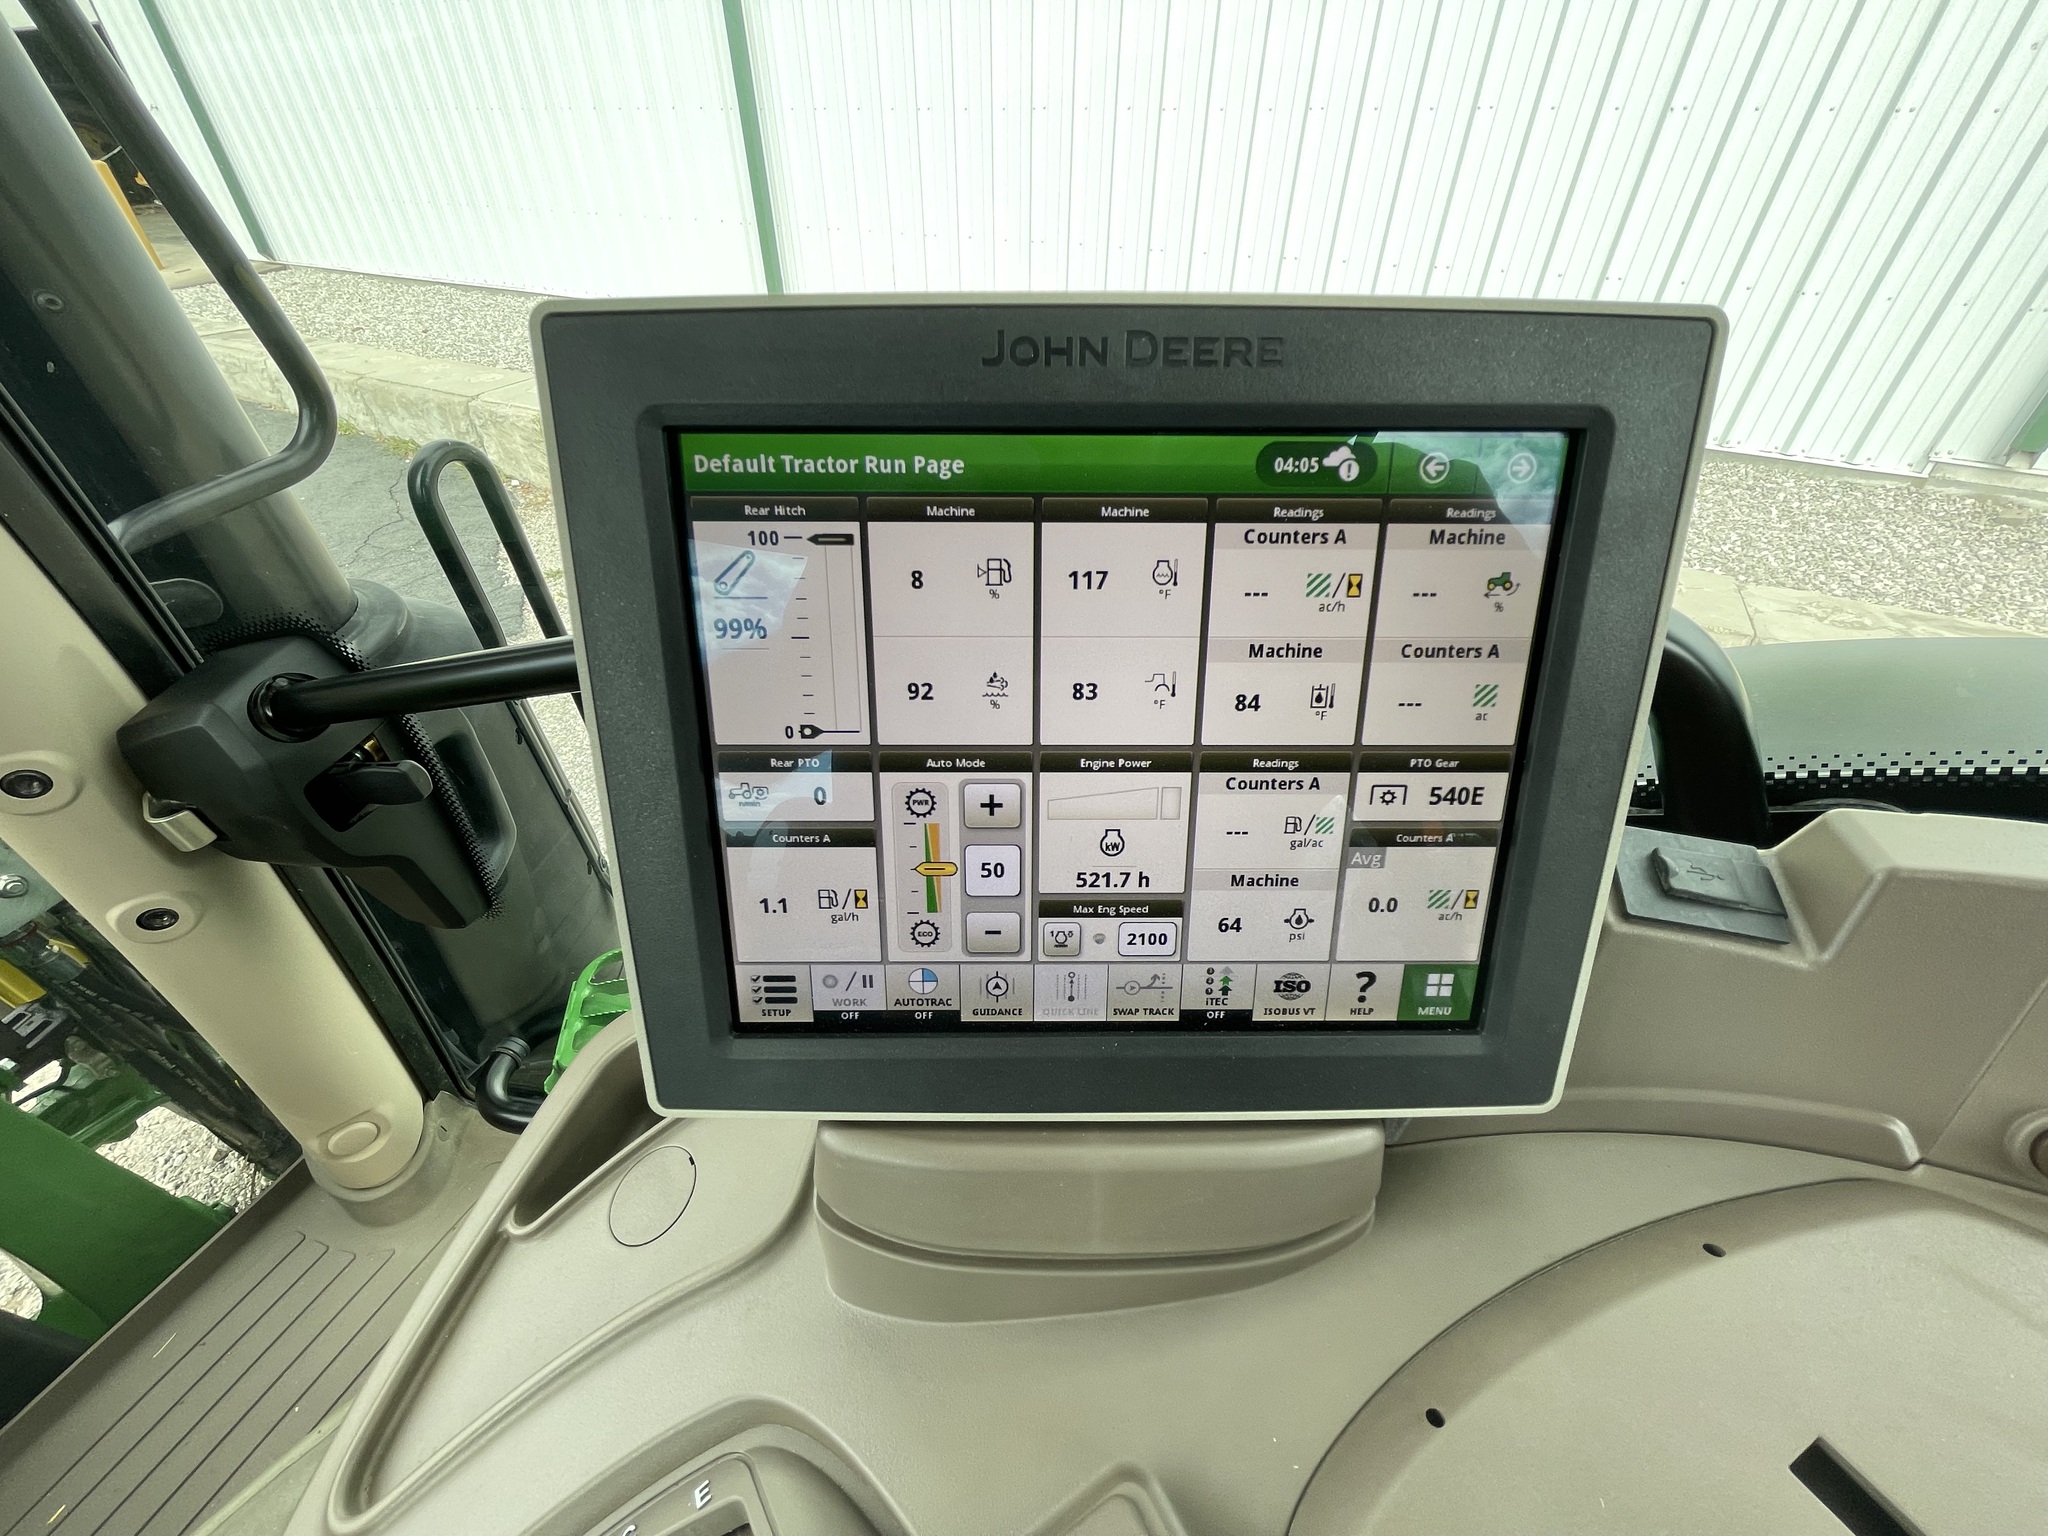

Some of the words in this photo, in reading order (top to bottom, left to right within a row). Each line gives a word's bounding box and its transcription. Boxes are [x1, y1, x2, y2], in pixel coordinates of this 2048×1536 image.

[981, 329, 1109, 367] JOHN
[1125, 329, 1285, 368] DEERE
[694, 454, 776, 475] Default
[781, 455, 859, 475] Tractor
[865, 456, 906, 475] Run
[914, 456, 965, 480] Page
[1274, 457, 1319, 474] 04:05
[744, 505, 770, 516] Rear
[773, 505, 806, 517] Hitch
[926, 505, 976, 517] Machine
[1101, 506, 1150, 517] Machine
[1273, 507, 1325, 521] Readings
[1446, 507, 1497, 521] Readings
[747, 530, 779, 546] 100
[1243, 529, 1330, 546] Counters
[1332, 529, 1347, 545] A
[1429, 529, 1506, 546] Machine
[910, 570, 924, 589] 8
[1068, 570, 1109, 590] 117
[989, 589, 1000, 600] %
[1318, 600, 1346, 613] ac/h
[1494, 602, 1504, 612] %
[713, 617, 768, 640] 99%
[1248, 643, 1323, 660] Machine
[1400, 643, 1484, 660] Counters
[1486, 643, 1500, 660] A
[907, 682, 934, 701] 92
[1072, 682, 1098, 701] 83
[990, 700, 1000, 710] %
[1234, 693, 1261, 713] 84
[1475, 712, 1488, 721] ac
[784, 725, 794, 739] 0
[770, 757, 796, 769] Rear
[798, 757, 820, 769] PTO
[926, 758, 954, 769] Auto
[956, 758, 986, 769] Mode
[1080, 758, 1115, 770] Engine
[1118, 758, 1152, 768] Power
[1252, 758, 1300, 771] Readings
[1410, 758, 1432, 769] PTO
[1434, 758, 1459, 769] Gear
[1225, 776, 1306, 792] Counters
[1308, 776, 1321, 791] A
[813, 787, 827, 806] 0
[913, 798, 929, 807] PWR
[1429, 787, 1485, 806] 540E
[771, 833, 817, 844] Counters
[819, 833, 831, 844] A
[1289, 837, 1324, 850] gal/ac
[1396, 833, 1443, 844] Counters
[1445, 833, 1454, 843] A
[1105, 842, 1121, 852] kW
[1351, 851, 1382, 869] Avg
[980, 862, 1006, 879] 50
[1076, 872, 1132, 888] 521.7
[1138, 872, 1150, 888] h
[1230, 873, 1300, 888] Machine
[759, 897, 788, 914] 1.1
[1073, 905, 1094, 914] Max
[1097, 905, 1116, 916] Eng
[1118, 905, 1149, 916] Speed
[1368, 898, 1398, 914] 0.0
[831, 911, 860, 924] gal/h
[1438, 911, 1463, 921] ac/h
[1217, 916, 1243, 934] 64
[917, 930, 934, 938] ECO
[1126, 932, 1168, 946] 2100
[1288, 930, 1306, 943] psi
[1273, 979, 1312, 993] ISO
[832, 997, 867, 1007] WORK
[894, 997, 952, 1007] AUTOTRAC
[1205, 997, 1229, 1006] iTEC
[761, 1008, 792, 1018] SETUP
[841, 1011, 860, 1020] OFF
[914, 1011, 933, 1020] OFF
[972, 1007, 1023, 1017] GUIDANCE
[1112, 1007, 1140, 1016] SWAP
[1144, 1007, 1175, 1016] TRACK
[1206, 1010, 1226, 1019] OFF
[1263, 1007, 1301, 1016] ISOBUS
[1303, 1007, 1316, 1015] VT
[1350, 1007, 1374, 1016] HELP
[1417, 1005, 1452, 1016] MENU
[694, 1479, 712, 1510] E
